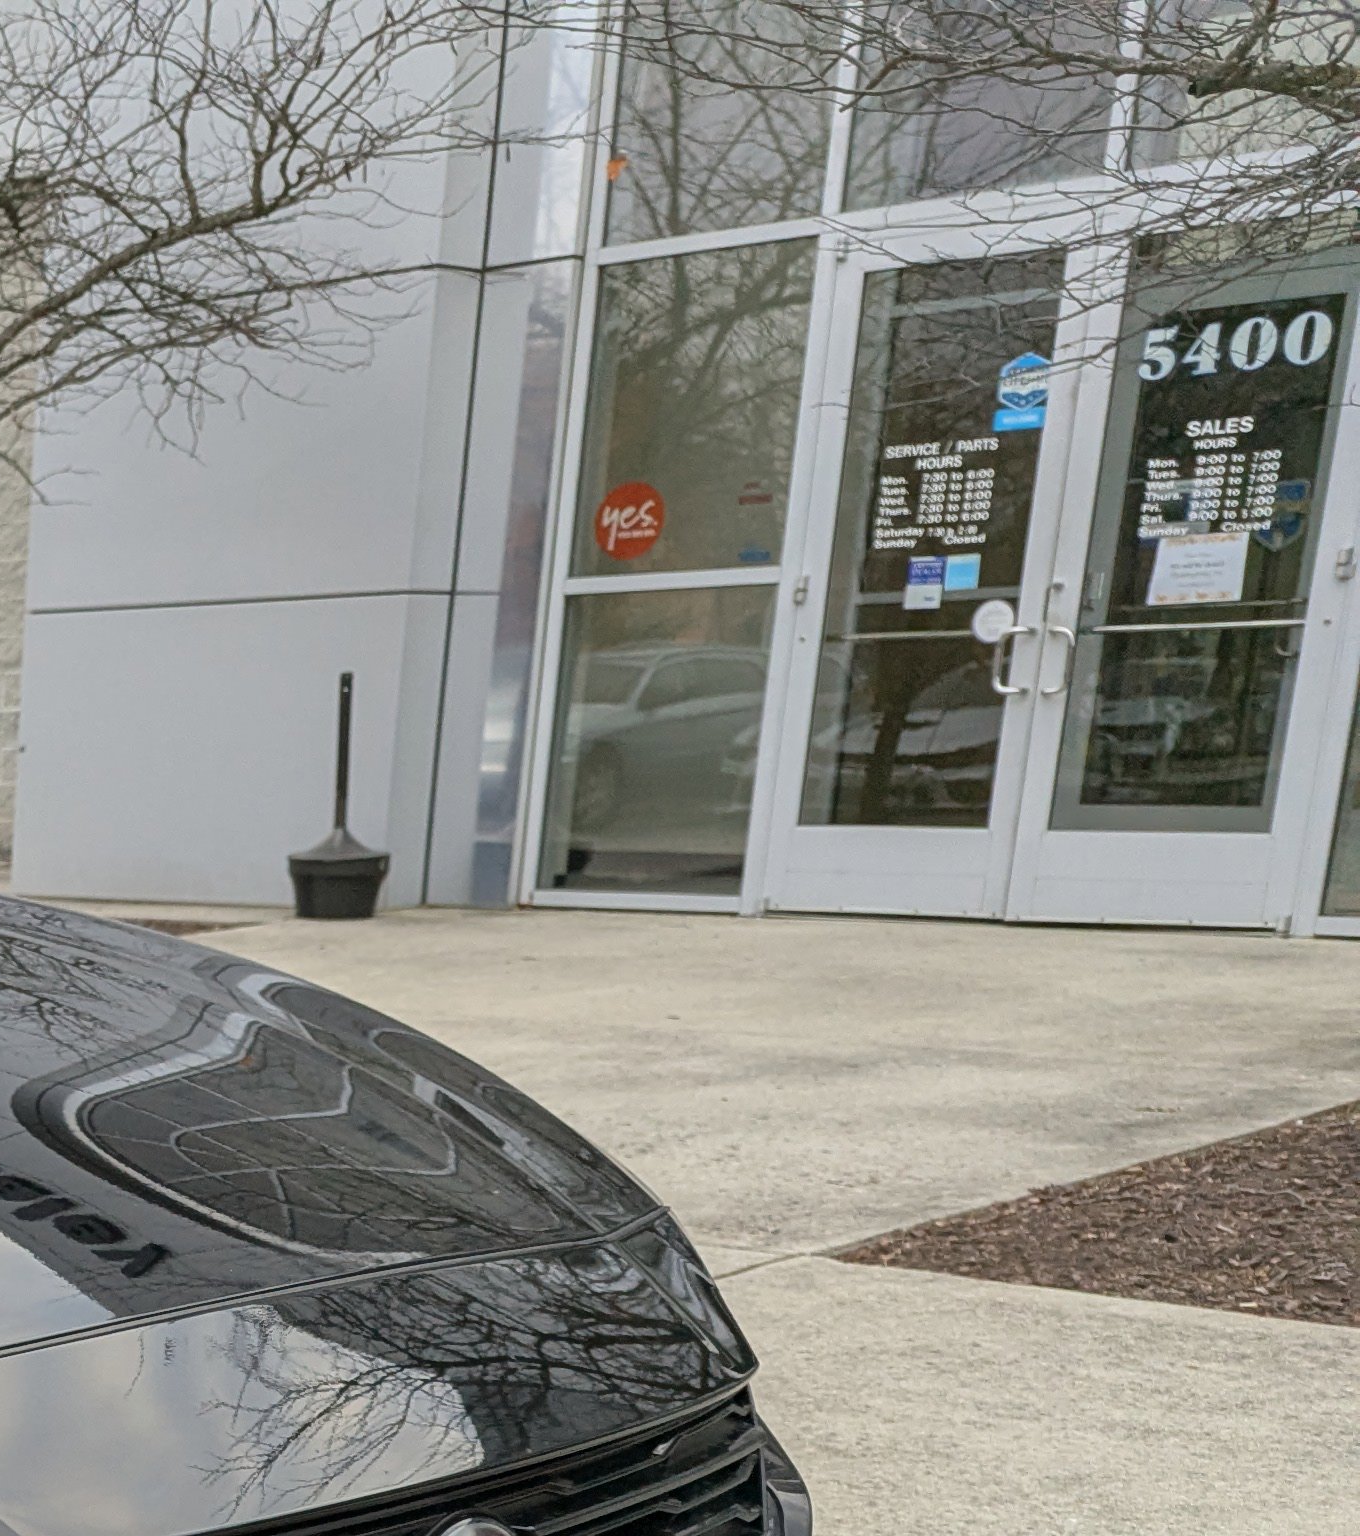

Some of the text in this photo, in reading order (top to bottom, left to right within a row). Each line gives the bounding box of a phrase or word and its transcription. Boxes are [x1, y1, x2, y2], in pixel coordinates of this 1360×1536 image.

[1138, 311, 1333, 381] 5400
[1185, 416, 1255, 437] SALES
[885, 442, 941, 459] SERVICE
[956, 437, 999, 452] PARTS
[1194, 437, 1237, 450] HOURS
[915, 454, 962, 470] HOURS
[1231, 453, 1246, 463] to
[1230, 465, 1245, 475] to
[1228, 476, 1243, 486] to
[1226, 488, 1241, 498] to
[1225, 499, 1240, 509] to
[1222, 510, 1237, 520] to
[1220, 520, 1271, 532] Closed
[876, 527, 925, 539] Saturday
[943, 532, 986, 545] Closed
